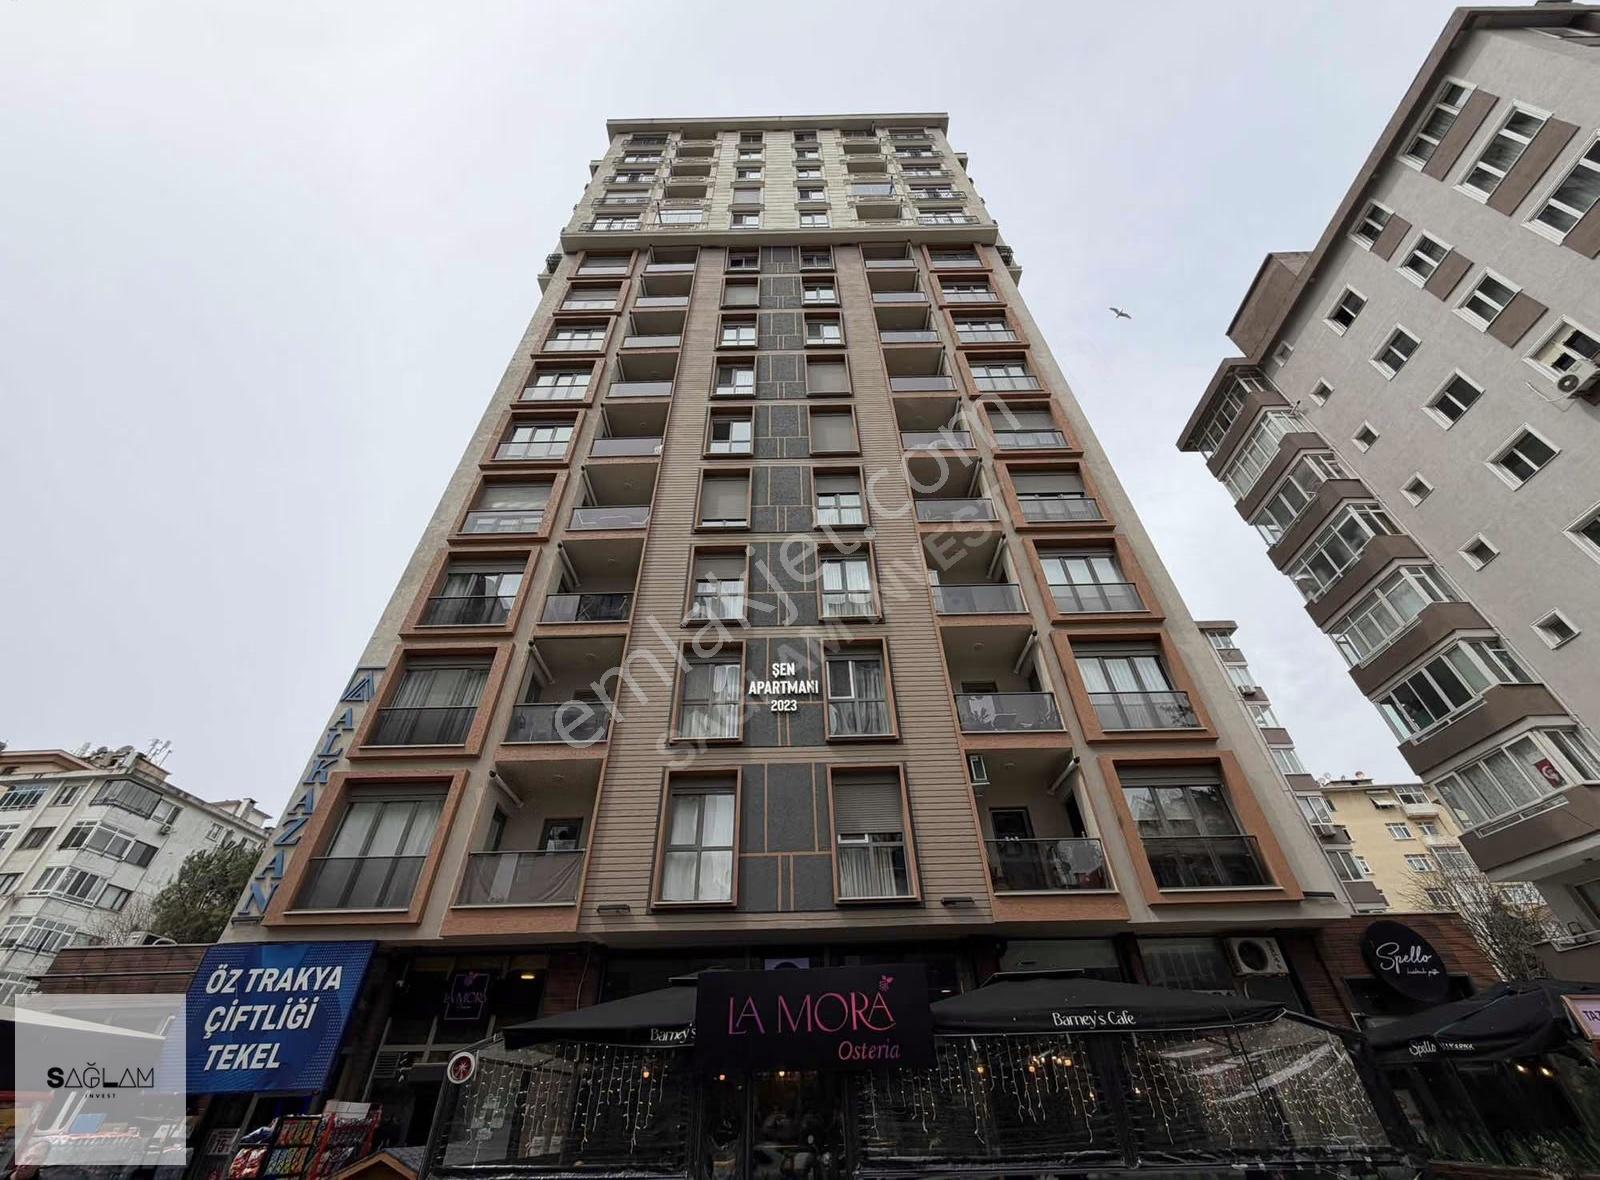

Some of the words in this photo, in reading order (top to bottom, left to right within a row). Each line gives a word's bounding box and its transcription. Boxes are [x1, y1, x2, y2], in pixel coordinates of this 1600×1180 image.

[772, 662, 795, 678] ŞEN
[748, 680, 819, 695] APARTMANI
[770, 699, 797, 712] 2023
[1376, 941, 1432, 975] Spello
[205, 963, 243, 994] ÖZ
[245, 966, 343, 993] TRAKYA
[203, 996, 320, 1039] ÇİFTLİĞİ
[728, 995, 766, 1035] LA
[777, 990, 896, 1033] MORA
[1052, 1010, 1107, 1029] Barney's
[1107, 1010, 1136, 1025] Cafe
[203, 1043, 281, 1071] TEKEL
[838, 1038, 901, 1061] Osteria
[1408, 1040, 1437, 1058] Spello
